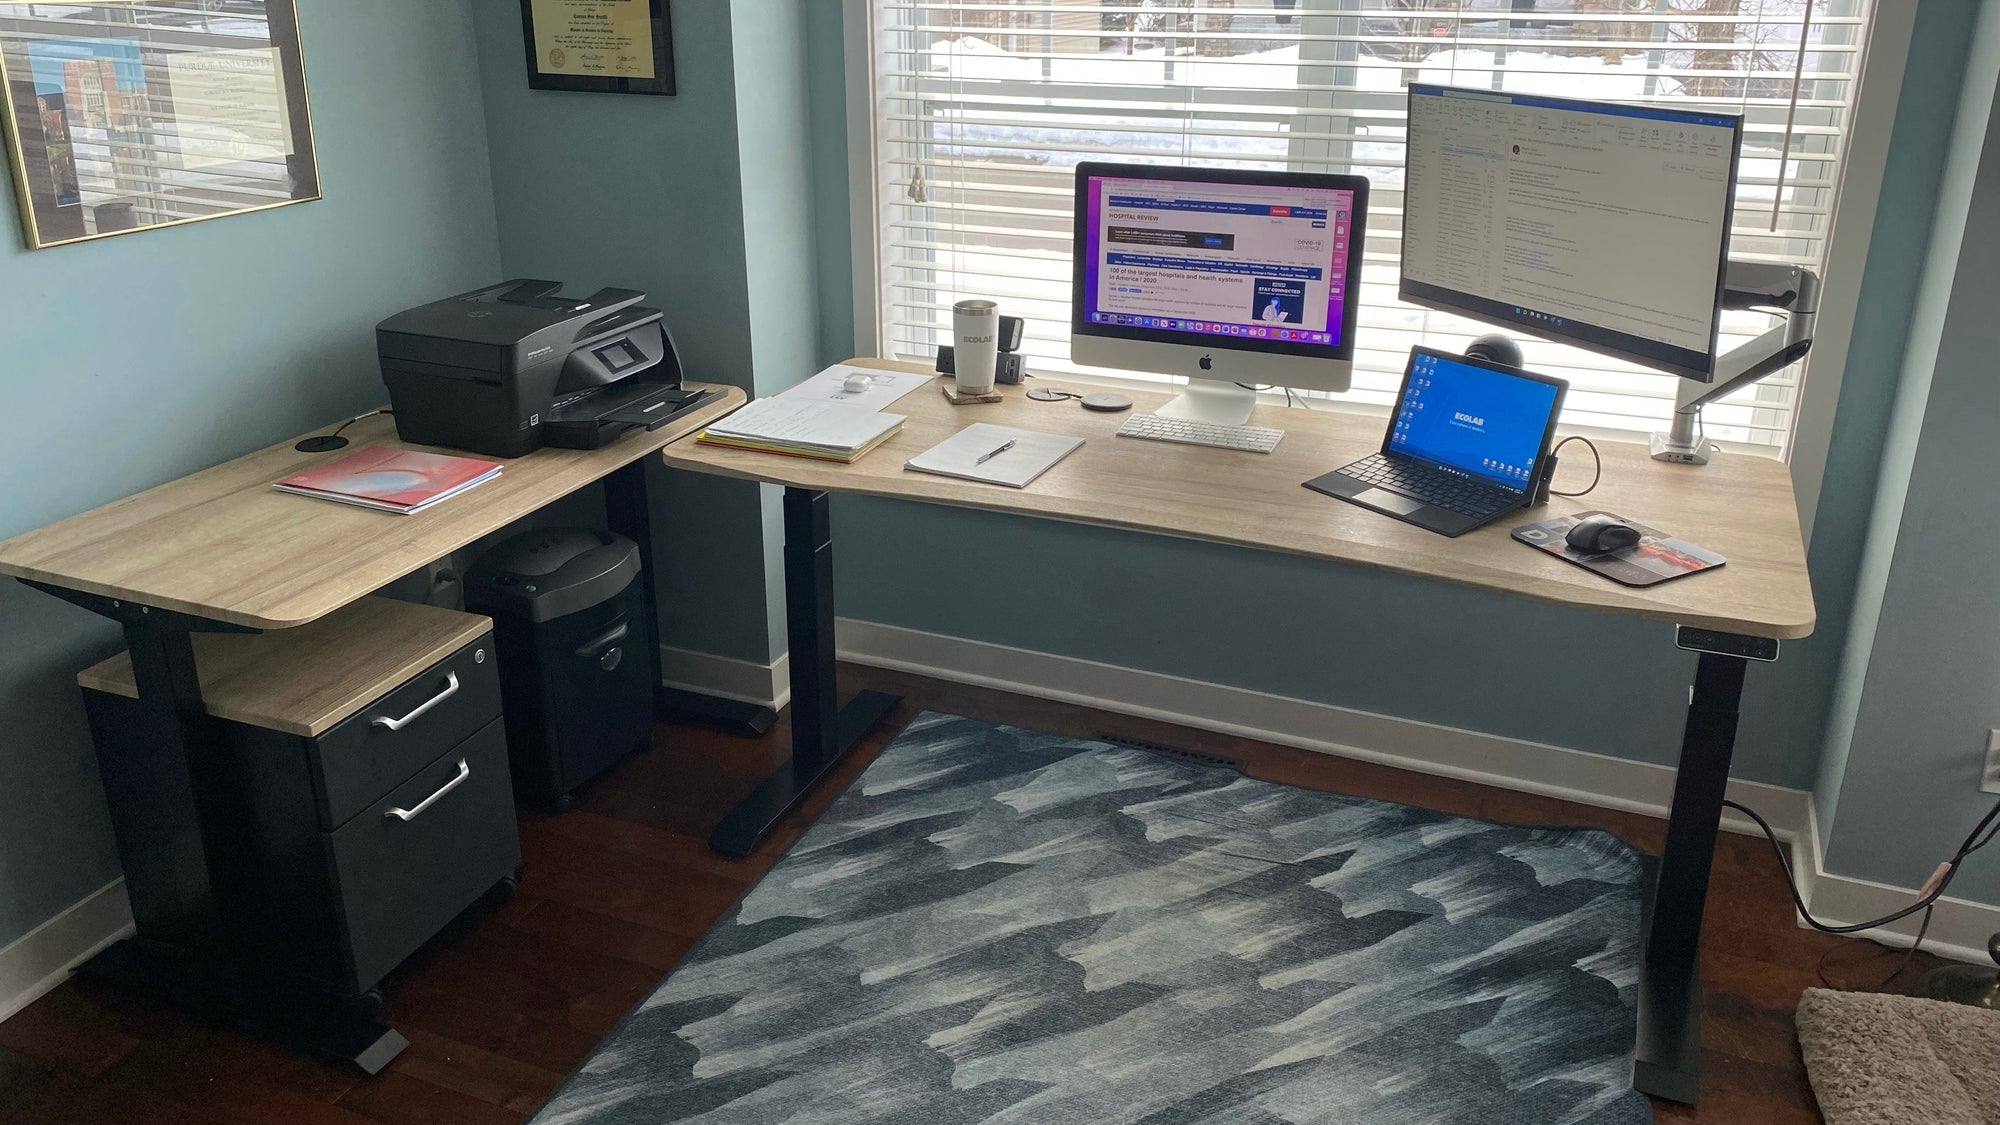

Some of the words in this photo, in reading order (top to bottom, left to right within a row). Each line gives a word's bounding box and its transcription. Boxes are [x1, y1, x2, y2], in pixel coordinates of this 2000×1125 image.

[178, 61, 216, 72] PURDUE
[219, 58, 273, 69] UNIVERSITY
[1137, 214, 1159, 222] REVIEW
[1138, 269, 1157, 277] largest
[1159, 271, 1185, 280] hospitals
[1454, 411, 1484, 426] ECOLAB
